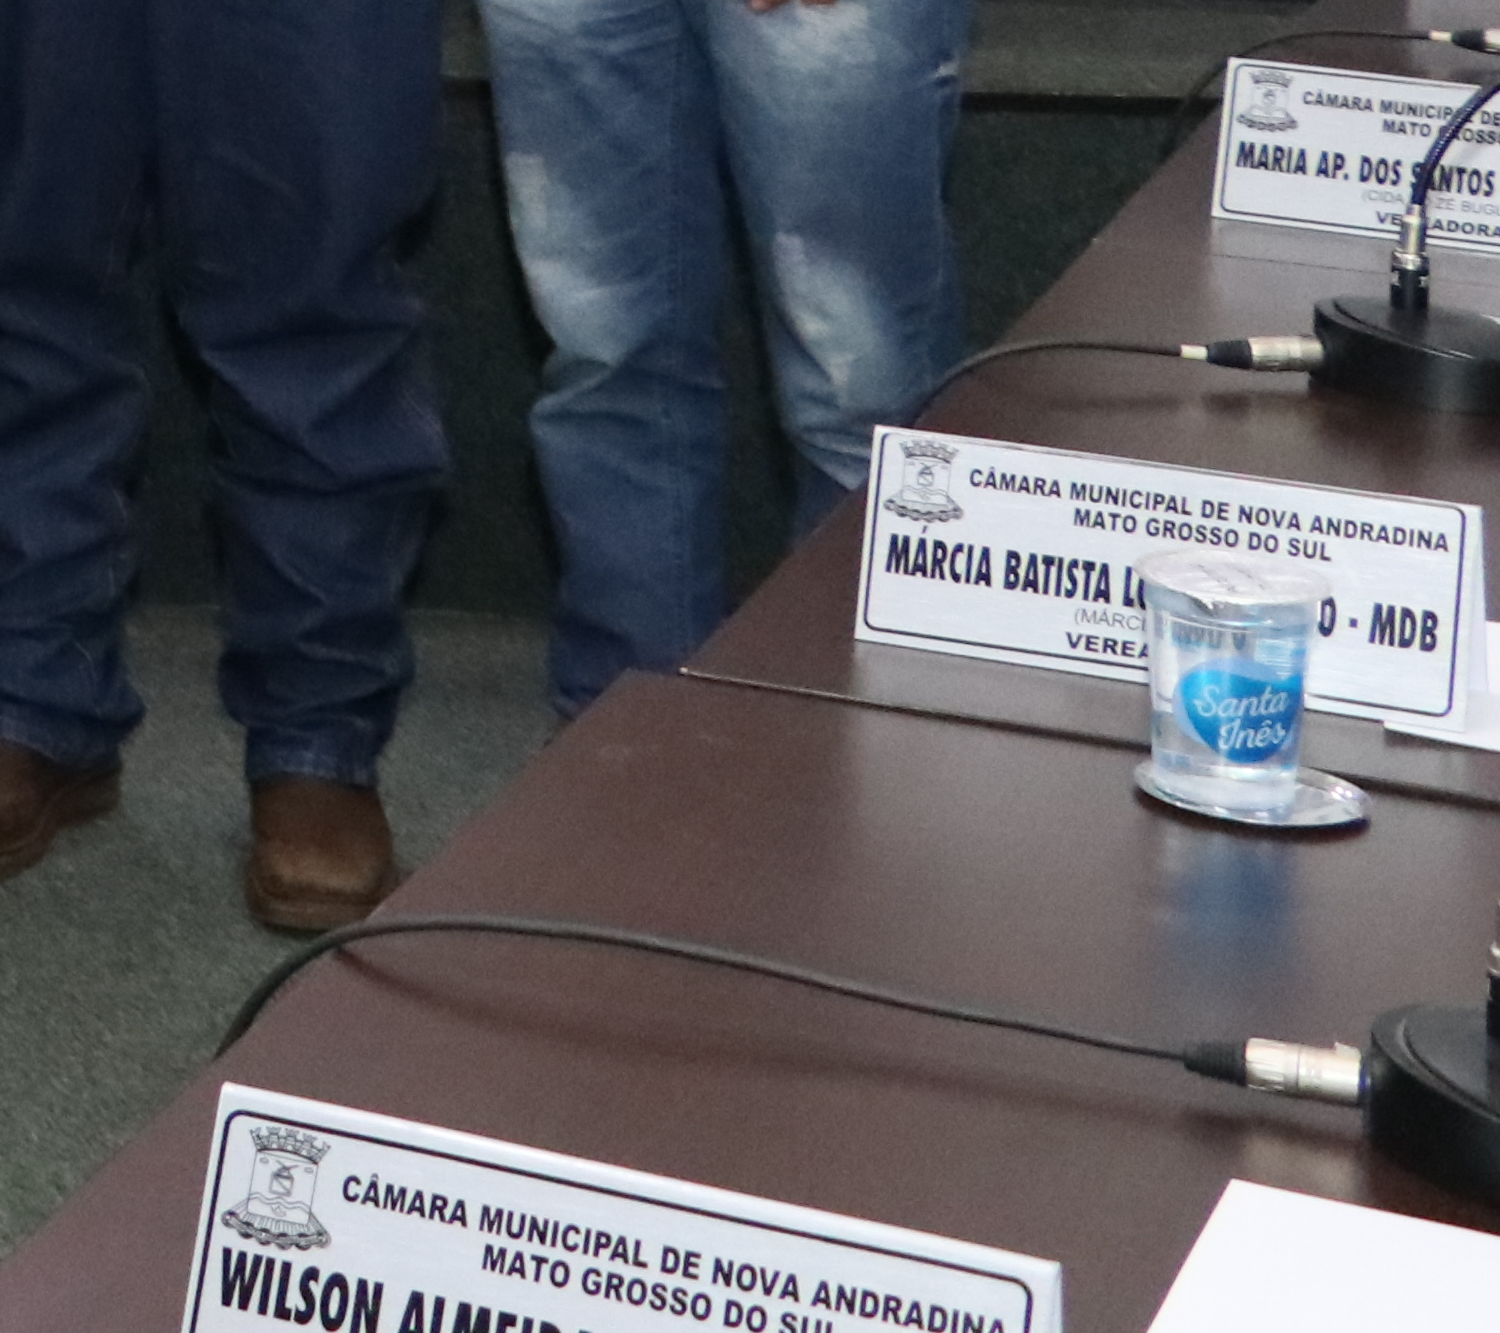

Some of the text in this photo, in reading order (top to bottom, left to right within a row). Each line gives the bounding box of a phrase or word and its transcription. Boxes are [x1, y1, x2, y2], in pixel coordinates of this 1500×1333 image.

[1303, 89, 1374, 113] CÂMARA
[1382, 118, 1432, 138] MATO
[1236, 140, 1308, 175] MARIA
[1316, 151, 1349, 181] AP.
[1359, 155, 1402, 186] DOS
[969, 466, 1449, 553] CÂMARA MUNICIPAL DE NOVA ANDRADINA
[1073, 507, 1333, 562] MATO GROSSO DO SUL
[885, 524, 993, 588] MÁRCIA
[1002, 548, 1111, 605] BATISTA
[1368, 601, 1440, 653] MDB
[1193, 684, 1289, 718] Santa
[1218, 719, 1288, 750] Inês
[341, 1171, 469, 1228] CÂMARA
[478, 1203, 649, 1270] MUNICIPAL
[659, 1244, 703, 1282] DE
[711, 1256, 802, 1303] NOVA
[220, 1245, 385, 1333] WILSON
[481, 1243, 571, 1289] MATO
[581, 1266, 712, 1321] GROSSO
[722, 1299, 768, 1333] DO
